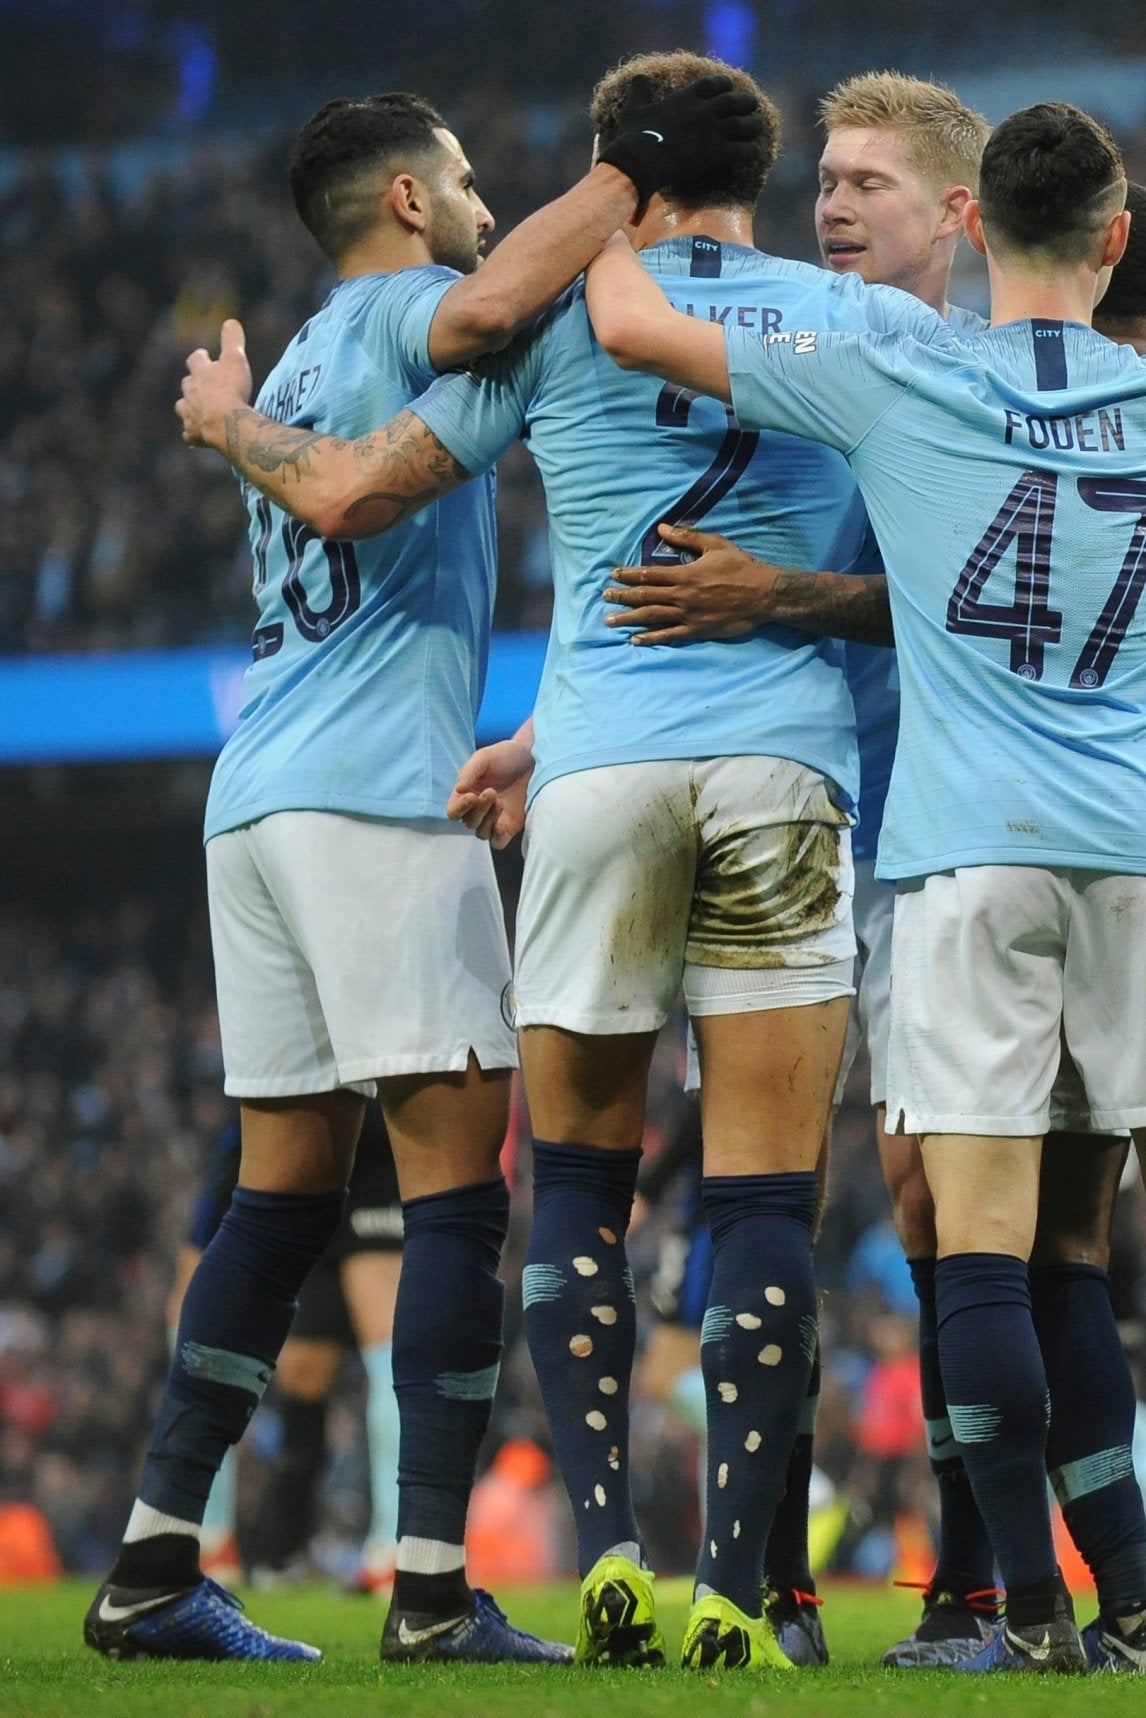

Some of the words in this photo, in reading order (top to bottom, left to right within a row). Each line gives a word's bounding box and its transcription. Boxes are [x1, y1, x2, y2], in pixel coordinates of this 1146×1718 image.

[694, 240, 719, 252] CITY
[1035, 329, 1060, 338] CITY
[1004, 407, 1126, 452] FODEN
